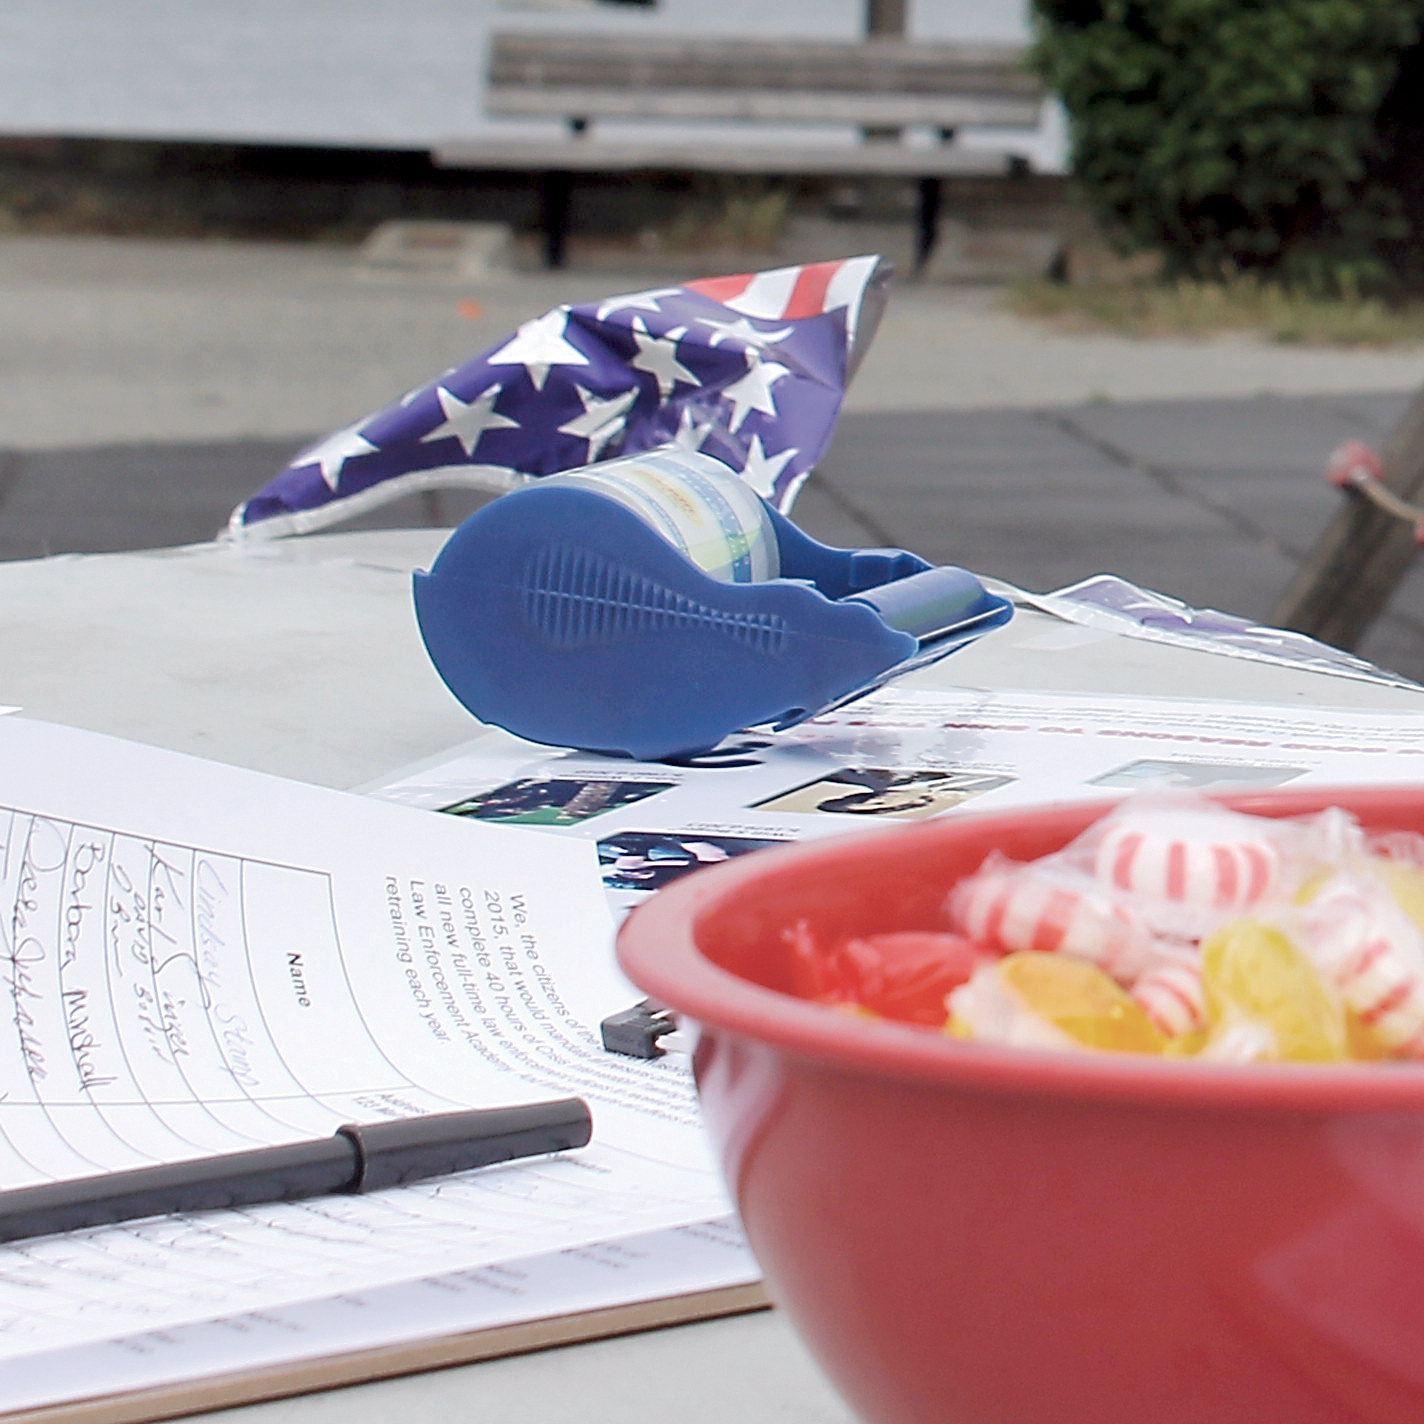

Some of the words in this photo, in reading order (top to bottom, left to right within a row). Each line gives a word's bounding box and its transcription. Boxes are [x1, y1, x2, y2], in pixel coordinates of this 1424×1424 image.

[434, 882, 452, 905] all
[509, 894, 529, 928] We,
[409, 880, 429, 919] Law
[419, 925, 469, 1028] Enforcement
[436, 911, 459, 949] new
[483, 890, 508, 940] 2015,
[498, 945, 523, 976] that
[513, 980, 544, 1020] would
[518, 934, 540, 960] the
[287, 952, 311, 1009] Name
[384, 876, 413, 964] retraining
[405, 969, 430, 1008] each
[420, 1012, 451, 1046] year.
[450, 952, 485, 1014] full-time
[459, 887, 491, 968] complete
[484, 972, 504, 992] 40
[494, 995, 526, 1032] hours
[531, 964, 570, 1016] citizens
[479, 1017, 505, 1037] law
